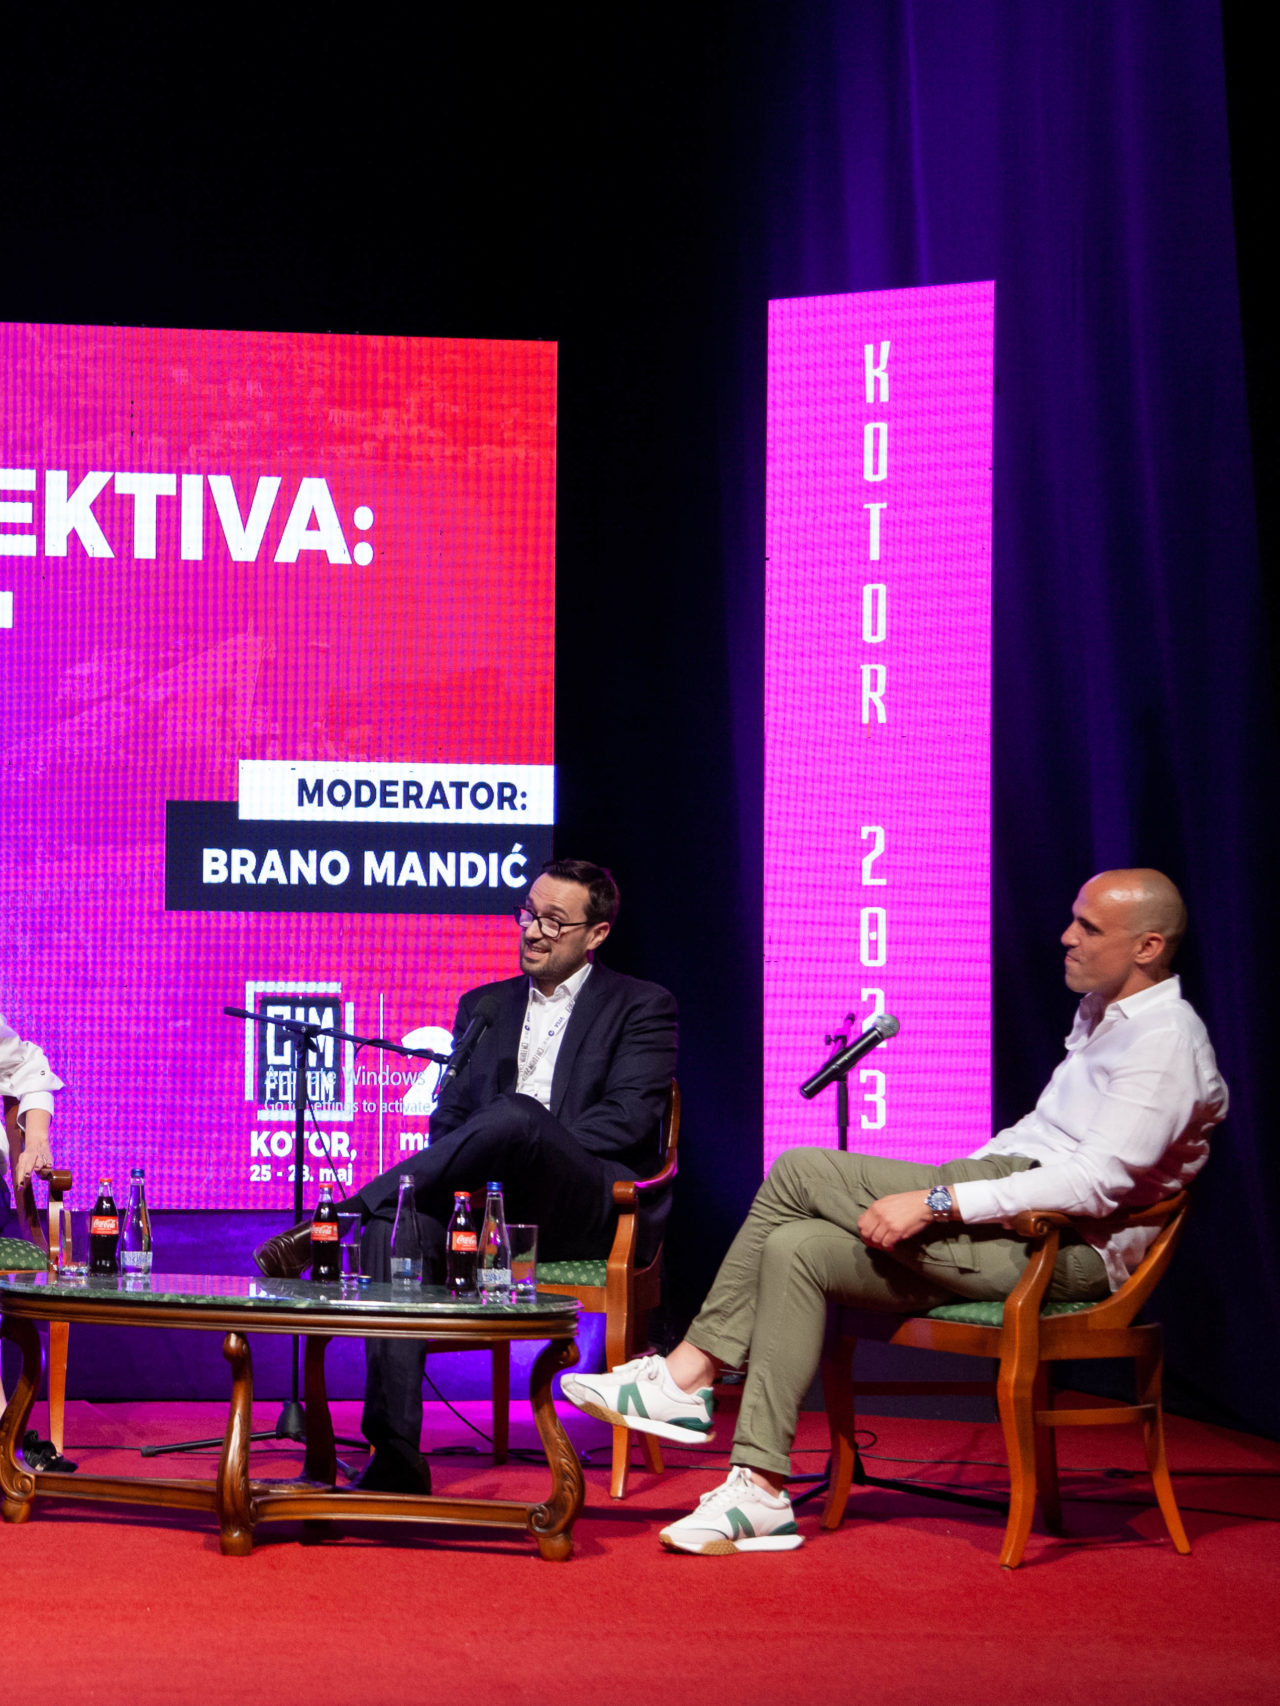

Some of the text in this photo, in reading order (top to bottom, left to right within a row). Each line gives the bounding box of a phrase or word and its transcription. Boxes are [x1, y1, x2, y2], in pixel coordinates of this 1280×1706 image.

[859, 341, 890, 1130] KOTOR 2023
[297, 777, 528, 811] MODERATOR:
[202, 842, 528, 889] BRANO MANDIĆ
[263, 1065, 425, 1086] Actate Windows
[265, 1071, 336, 1101] FOUM
[362, 1100, 376, 1113] to
[249, 1164, 272, 1183] 25
[319, 1162, 353, 1187] maj
